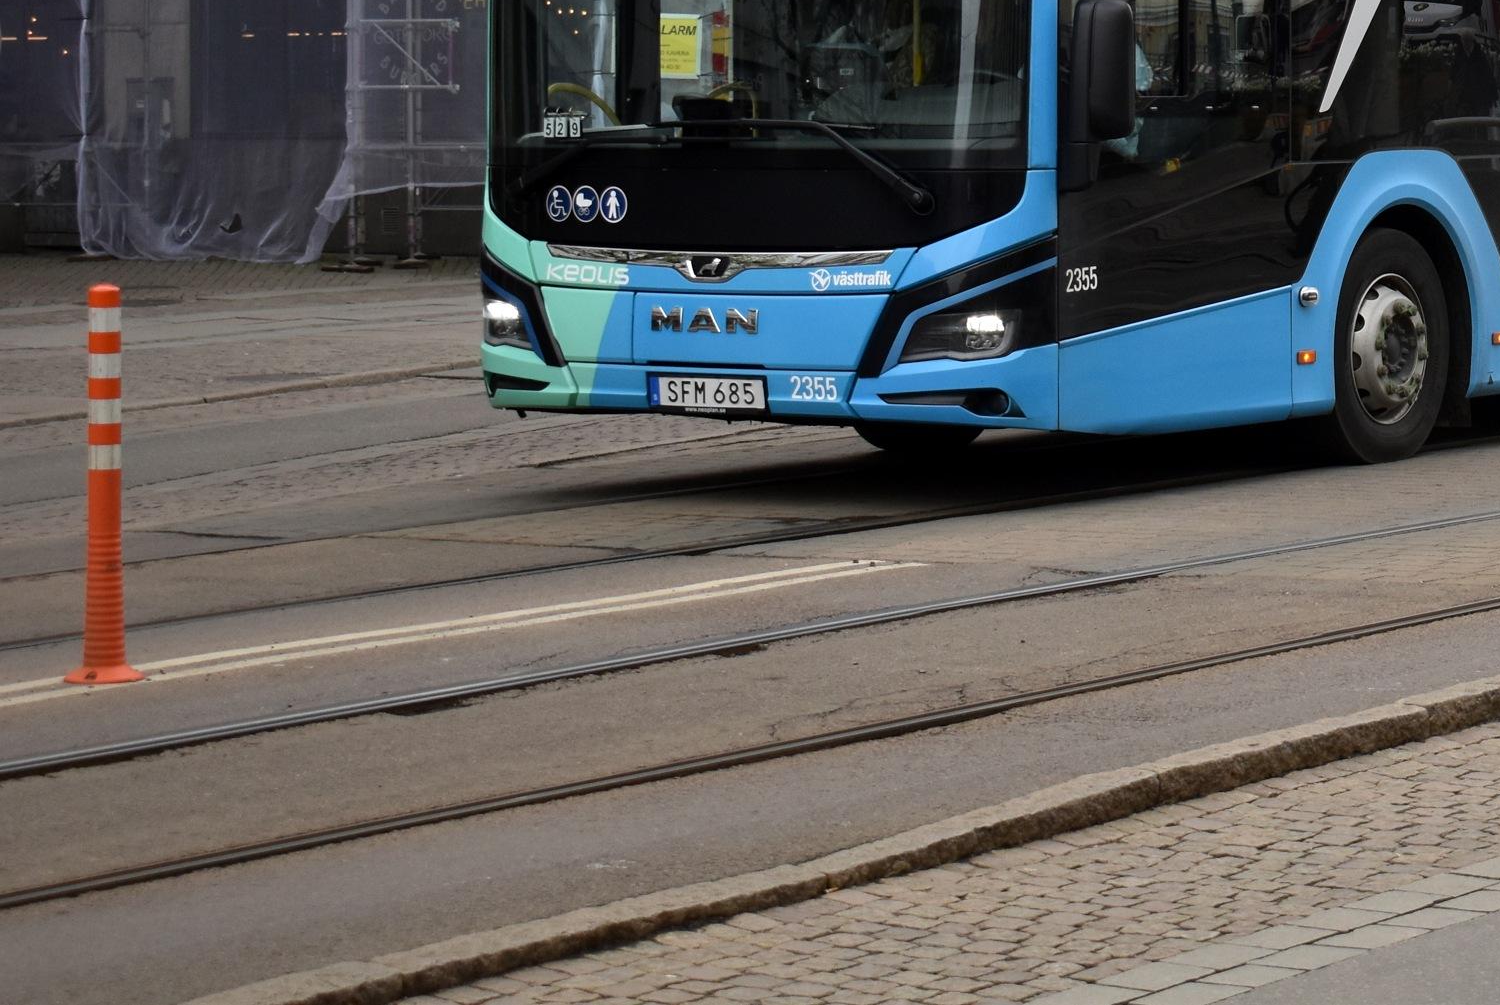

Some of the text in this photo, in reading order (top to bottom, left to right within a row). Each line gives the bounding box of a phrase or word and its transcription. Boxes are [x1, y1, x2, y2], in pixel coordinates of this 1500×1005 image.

[545, 122, 579, 136] 529
[832, 270, 891, 286] västtrafik
[1066, 266, 1098, 293] 2355
[651, 306, 759, 335] MAN
[667, 380, 755, 405] SFM 685
[790, 375, 838, 401] 2355
